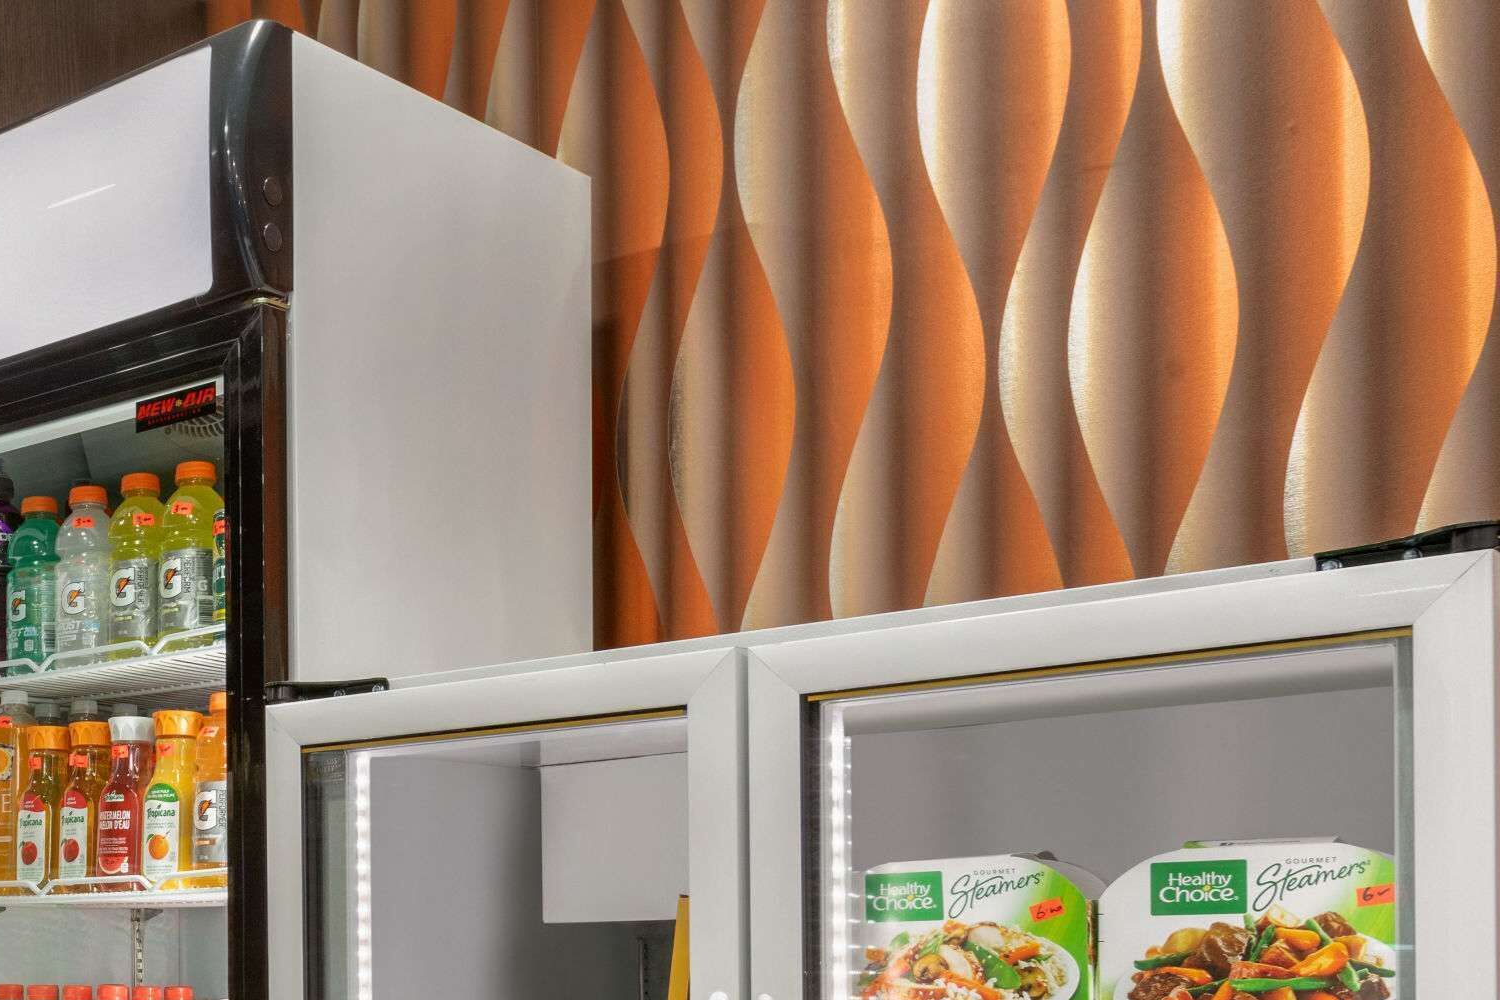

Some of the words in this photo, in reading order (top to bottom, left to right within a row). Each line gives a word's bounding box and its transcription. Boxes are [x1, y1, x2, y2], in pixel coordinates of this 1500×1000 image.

[137, 397, 177, 421] NEW
[181, 388, 217, 407] AIR
[111, 567, 136, 608] G
[159, 558, 182, 599] G
[10, 590, 26, 622] G
[61, 581, 86, 615] G
[20, 817, 43, 829] Tropicana
[61, 814, 85, 826] Tropicana
[147, 807, 176, 820] Tropicana
[194, 789, 217, 831] G
[973, 868, 1016, 876] GOURMET
[1285, 855, 1337, 865] GOURMET
[880, 883, 931, 897] Healthy
[948, 871, 1044, 920] Steamers
[1159, 883, 1239, 903] Choice
[1168, 871, 1232, 898] Healthy
[1252, 859, 1370, 912] Steamers
[872, 894, 937, 912] Choice
